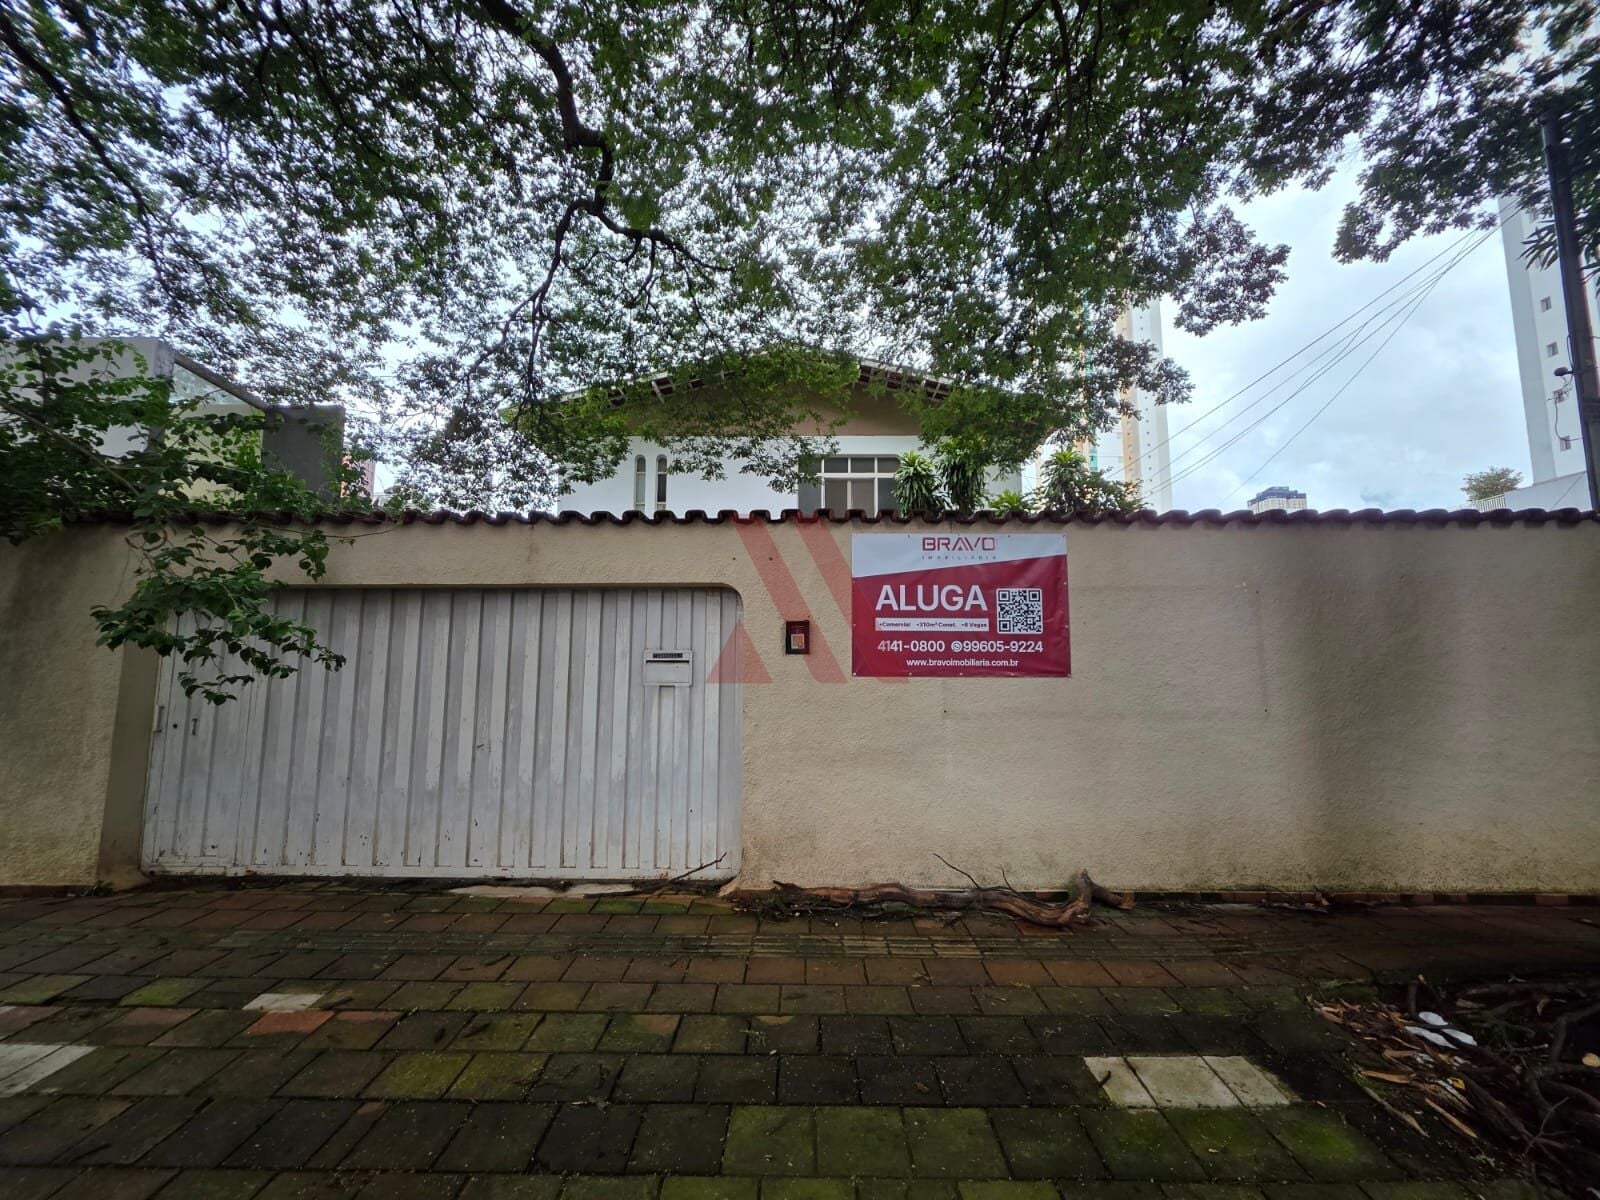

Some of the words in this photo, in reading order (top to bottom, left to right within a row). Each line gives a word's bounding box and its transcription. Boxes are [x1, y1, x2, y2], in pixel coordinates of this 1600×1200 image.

[922, 537, 995, 551] BRAVO
[875, 584, 988, 611] ALUGA
[877, 640, 945, 652] 4141-0800
[963, 640, 1043, 652] 99605-9224
[906, 658, 1019, 667] www.bravoimobiliaria.com.br
